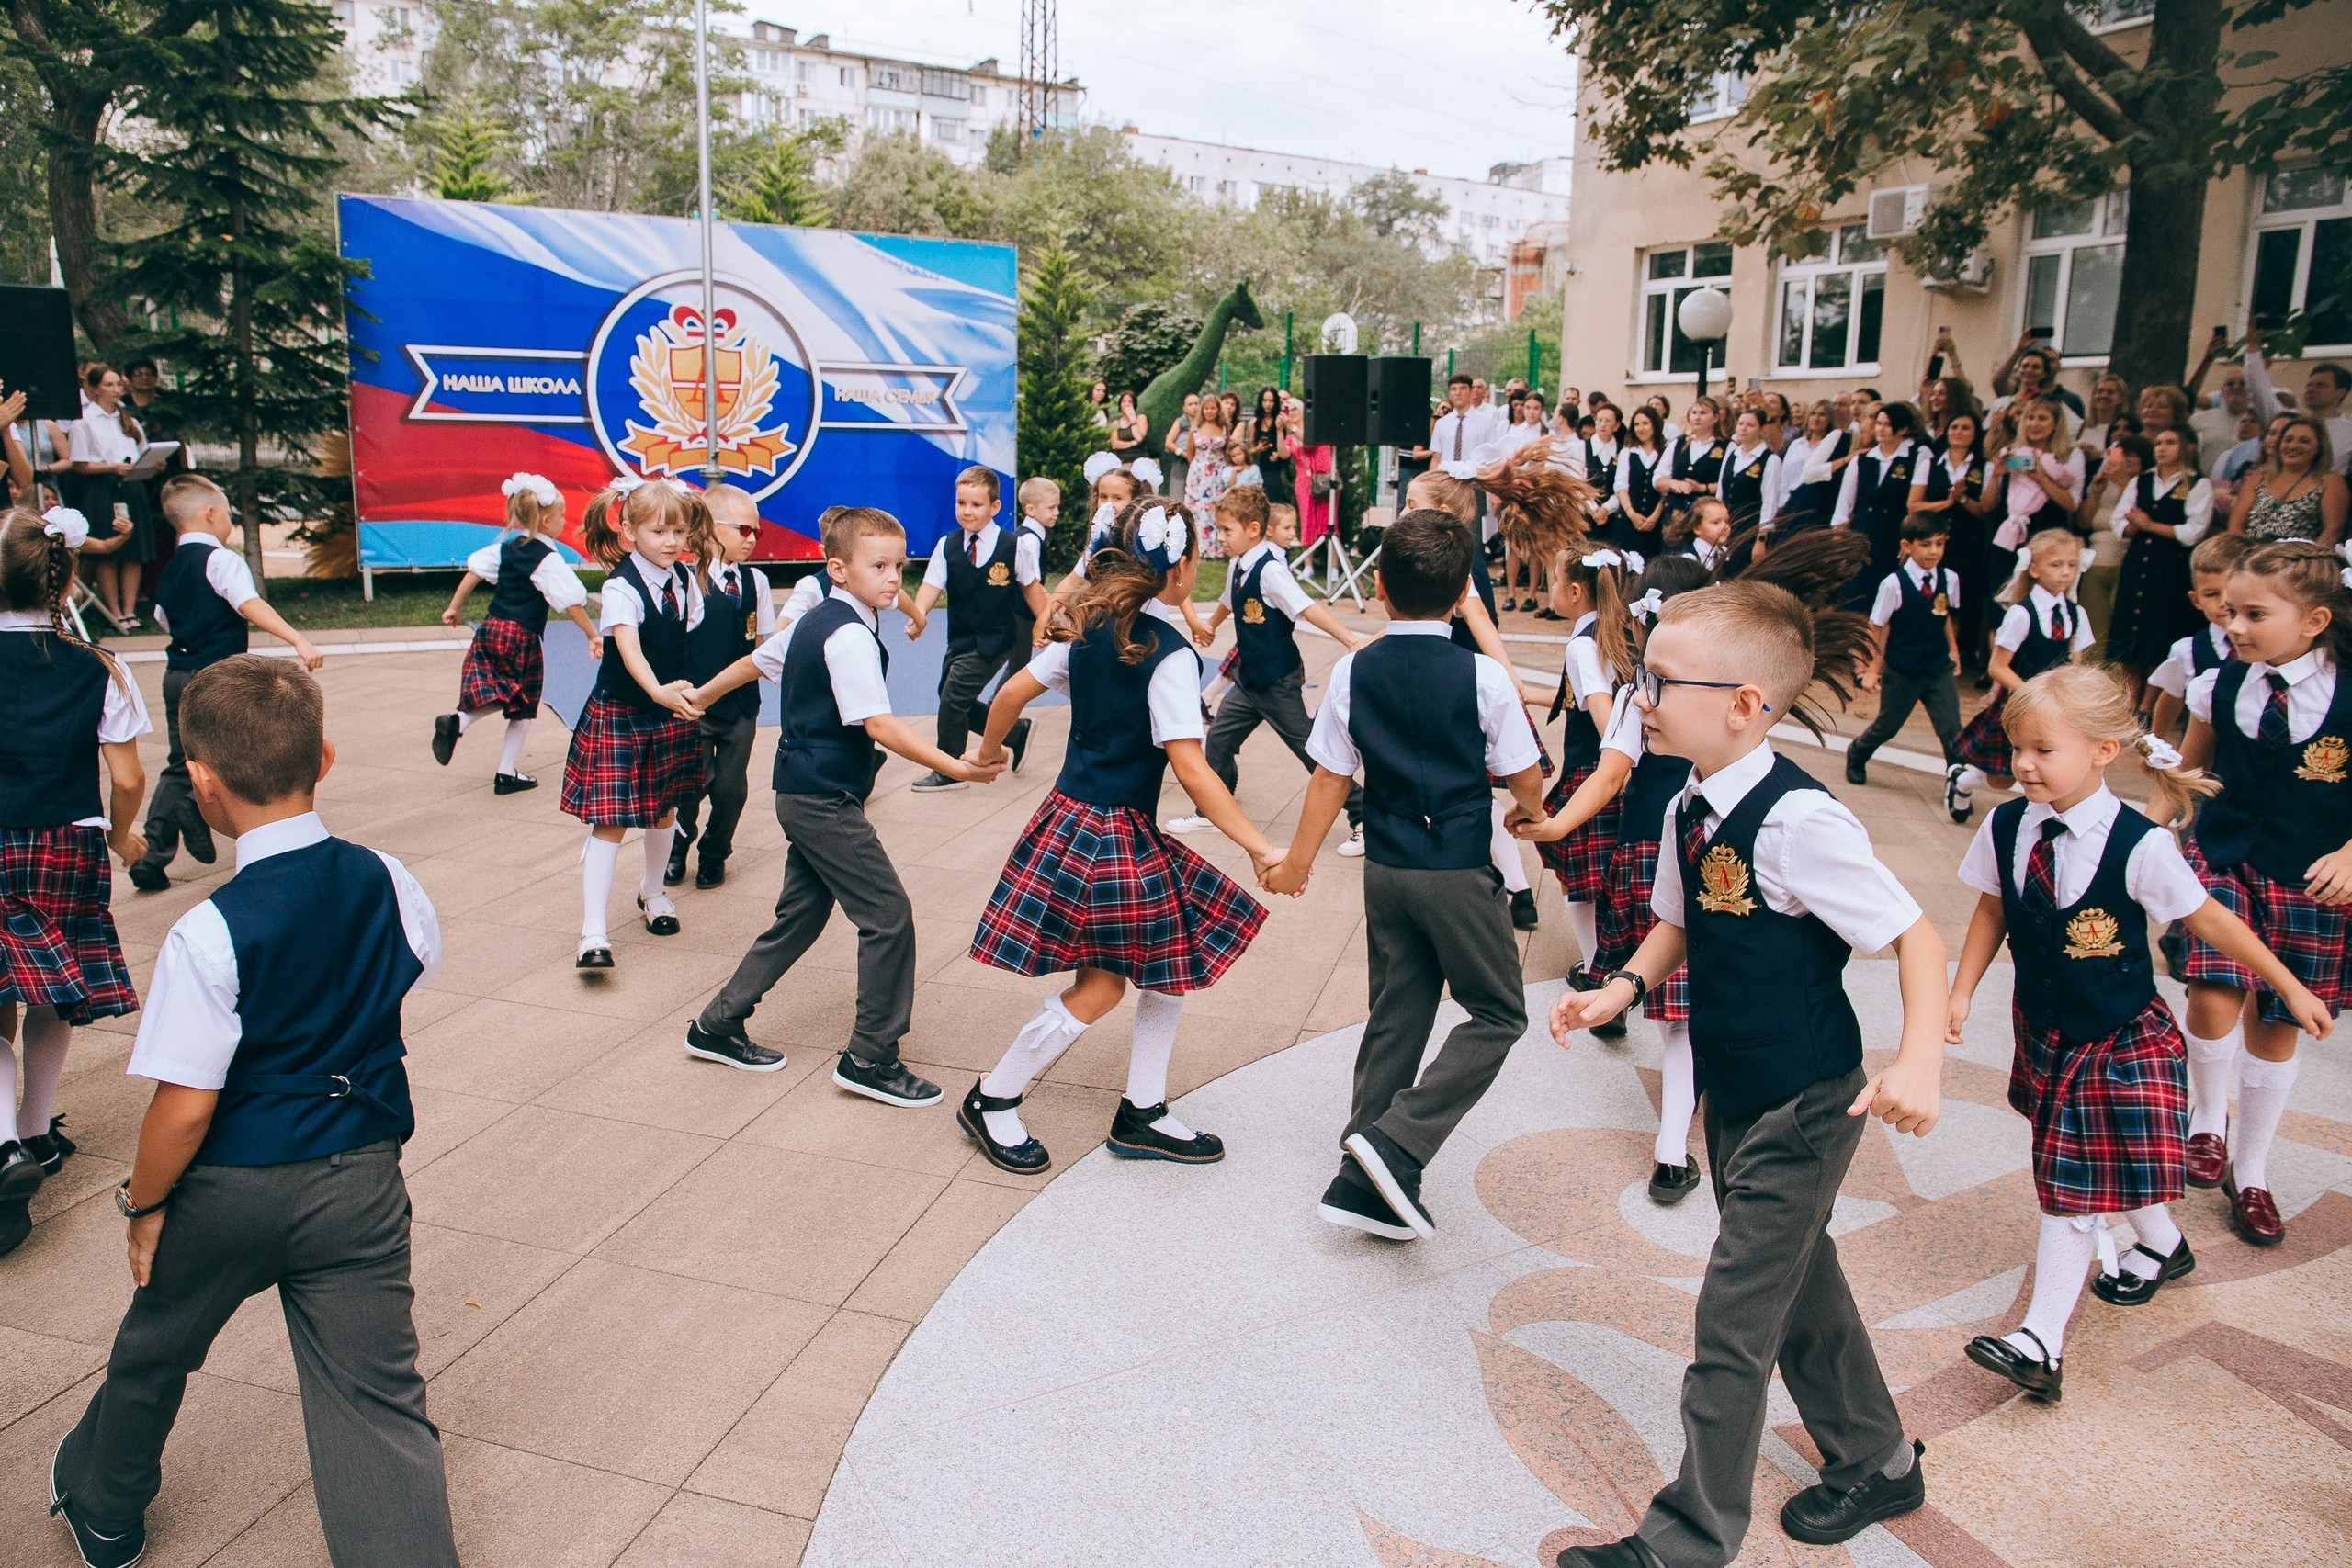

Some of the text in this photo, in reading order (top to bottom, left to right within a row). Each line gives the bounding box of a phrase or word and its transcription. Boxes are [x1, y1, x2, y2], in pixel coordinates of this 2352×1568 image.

[442, 373, 582, 395] НАША ШКОЛА
[833, 387, 936, 405] НАША СЕМЬЯ
